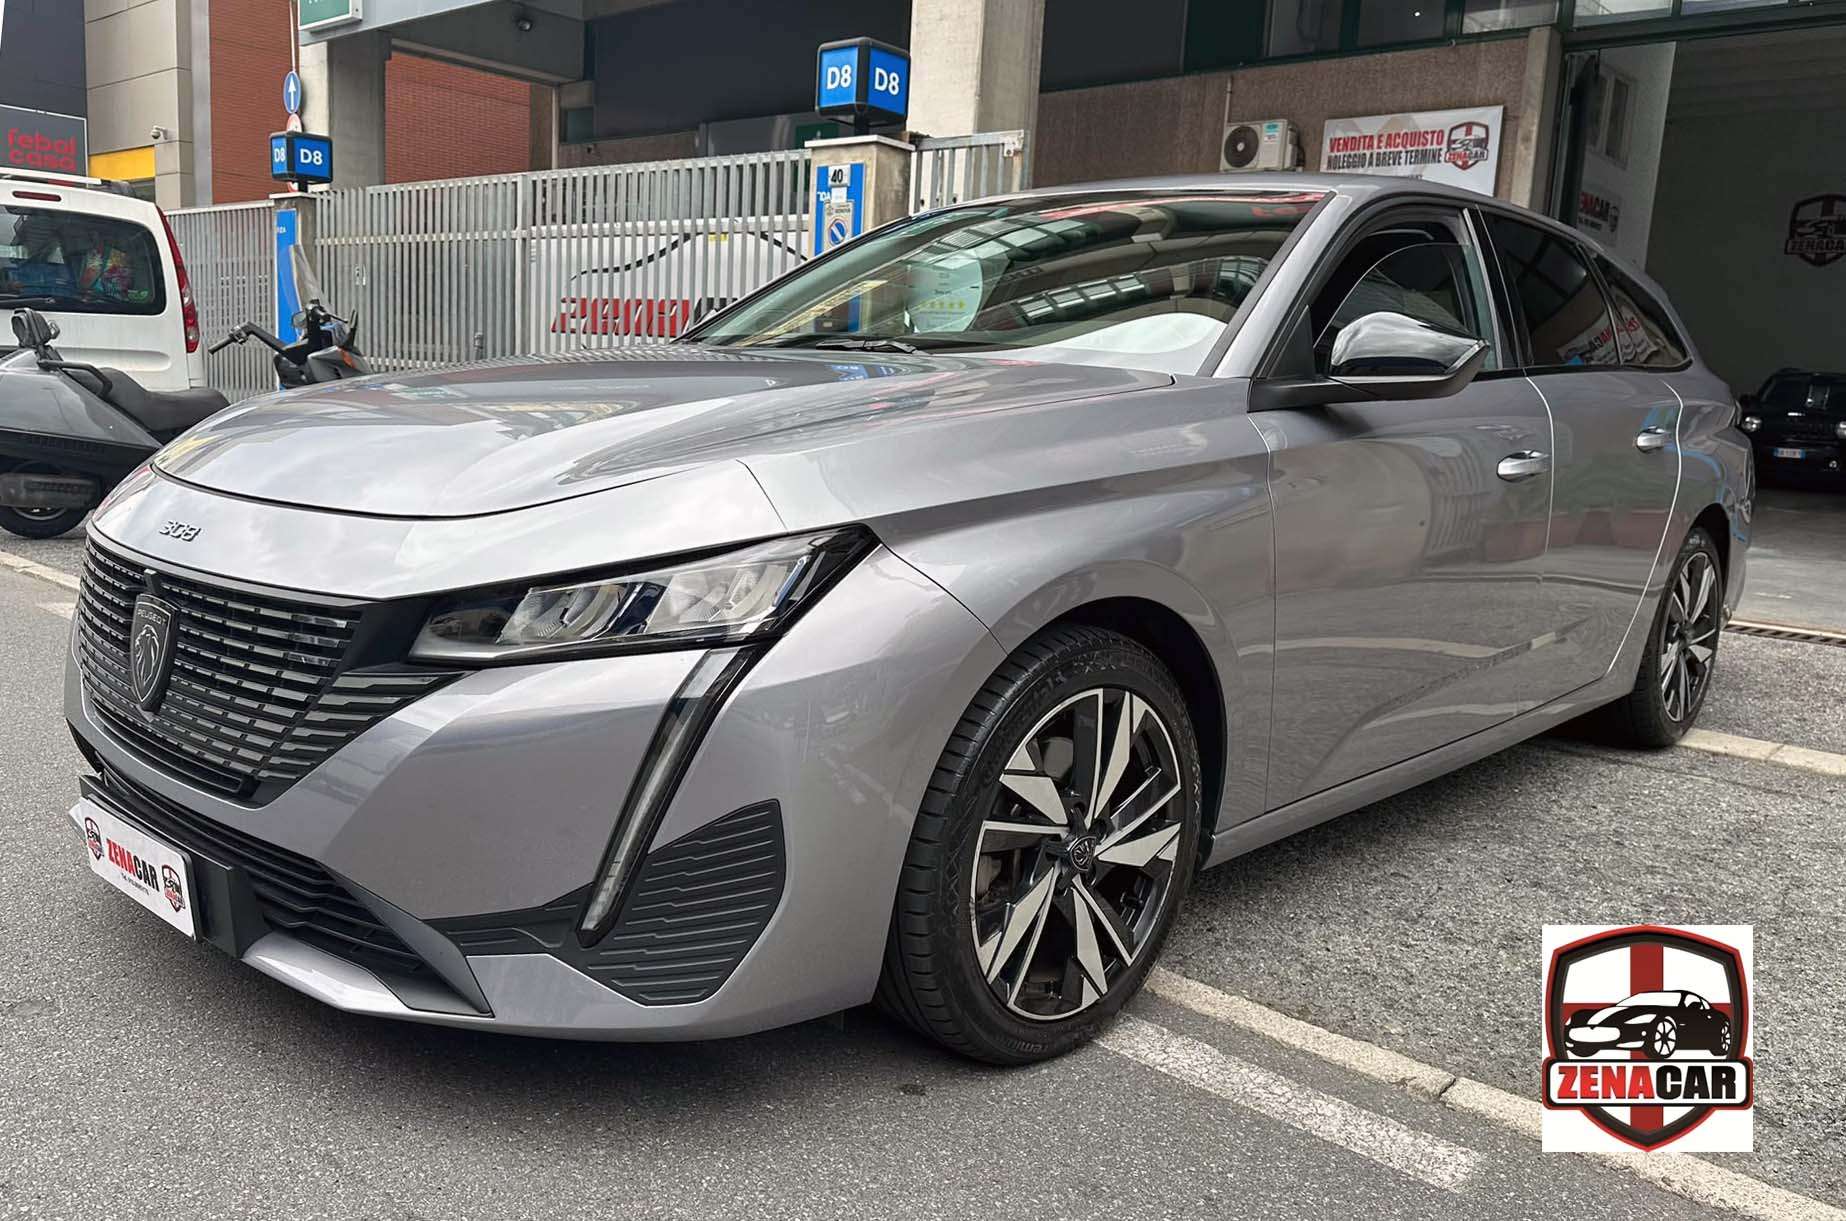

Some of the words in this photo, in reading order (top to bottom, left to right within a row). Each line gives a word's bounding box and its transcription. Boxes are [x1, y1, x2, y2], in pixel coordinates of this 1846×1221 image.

[826, 64, 852, 90] D8
[874, 67, 900, 95] D8
[1329, 134, 1374, 152] VENDITA
[1376, 133, 1384, 149] E
[1385, 129, 1445, 149] ACQUISTO
[274, 147, 286, 162] D8
[299, 148, 323, 165] D8
[1327, 152, 1367, 170] NOLEGGIO
[1367, 152, 1374, 168] A
[1375, 150, 1401, 167] BREVE
[1404, 148, 1443, 166] TERMINE
[830, 168, 844, 183] 40
[159, 520, 202, 542] 308
[106, 838, 160, 892] ZENACAR
